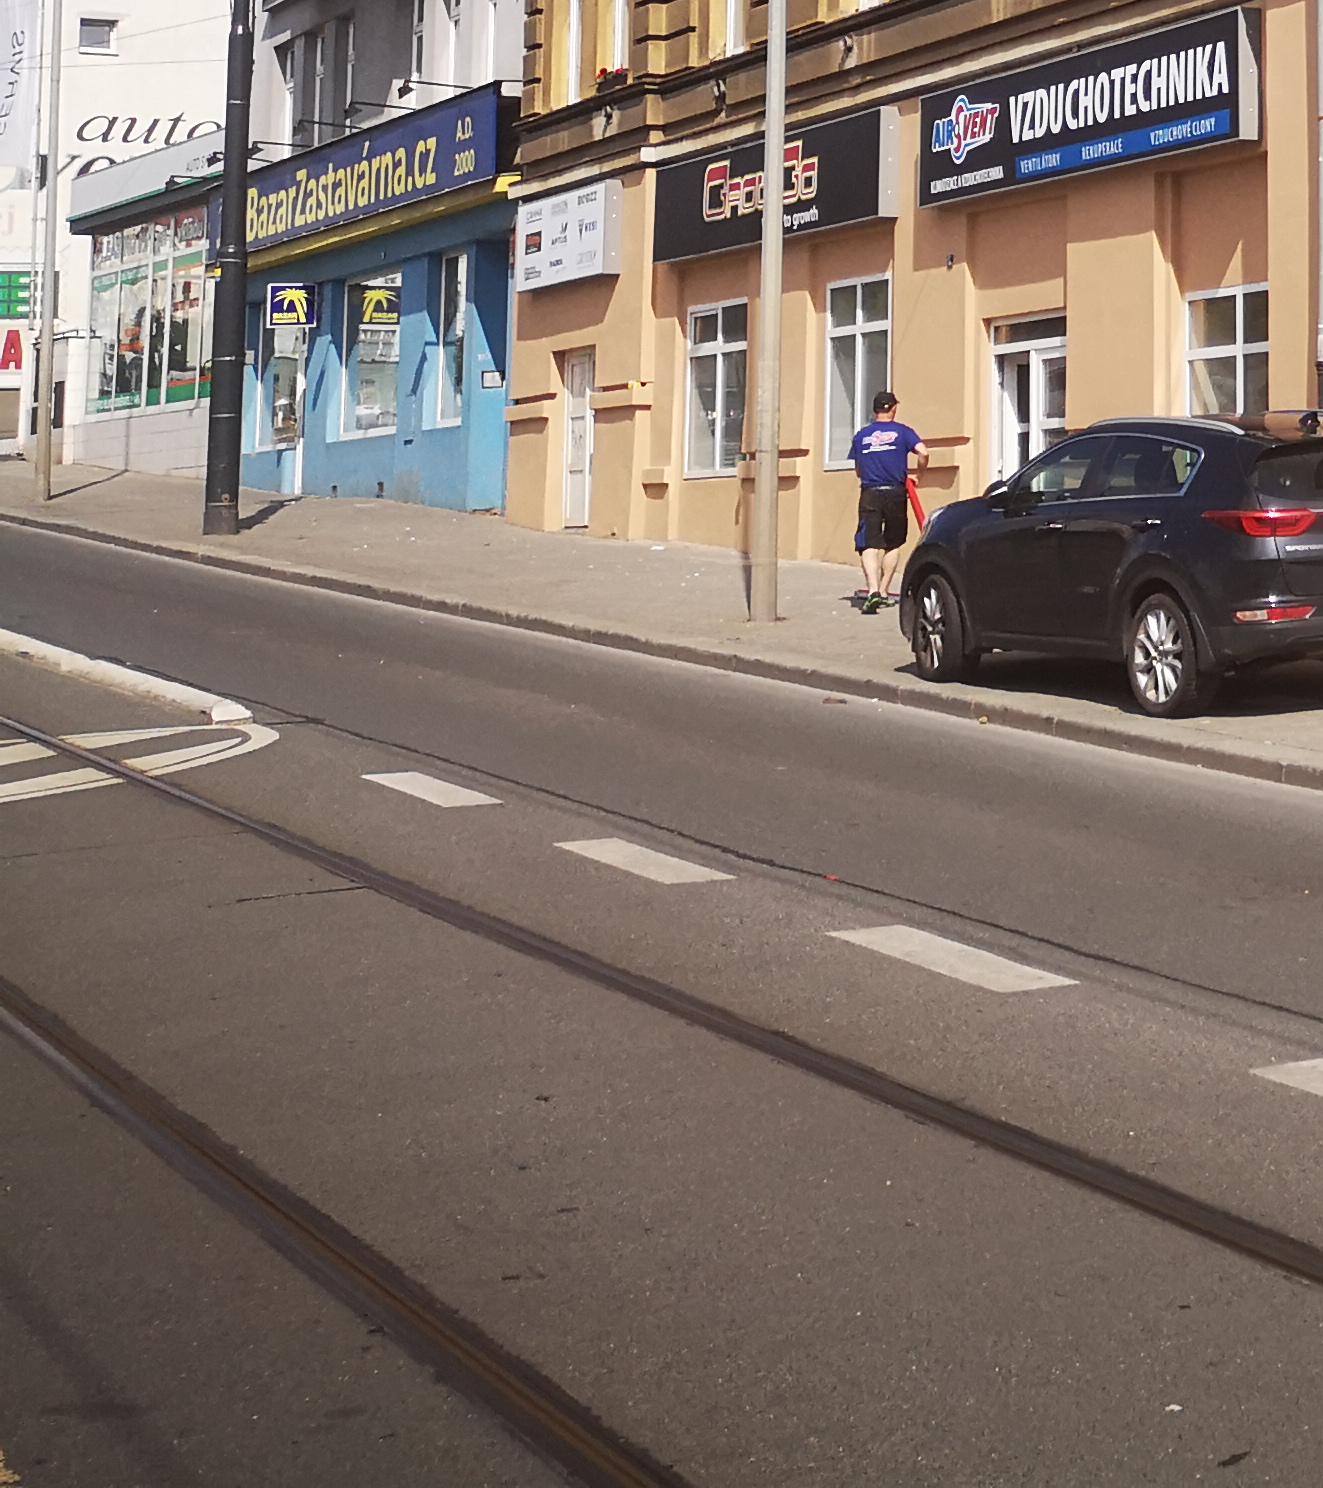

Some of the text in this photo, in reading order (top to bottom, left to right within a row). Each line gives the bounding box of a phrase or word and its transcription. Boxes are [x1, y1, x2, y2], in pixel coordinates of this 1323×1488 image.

[1009, 41, 1230, 144] VZDUCHOTECHNIKA
[456, 116, 474, 142] A.D.
[932, 106, 998, 152] AIR VENT
[453, 149, 475, 177] 2000
[247, 137, 437, 243] BazarZastavárna.cz
[792, 206, 819, 231] growth
